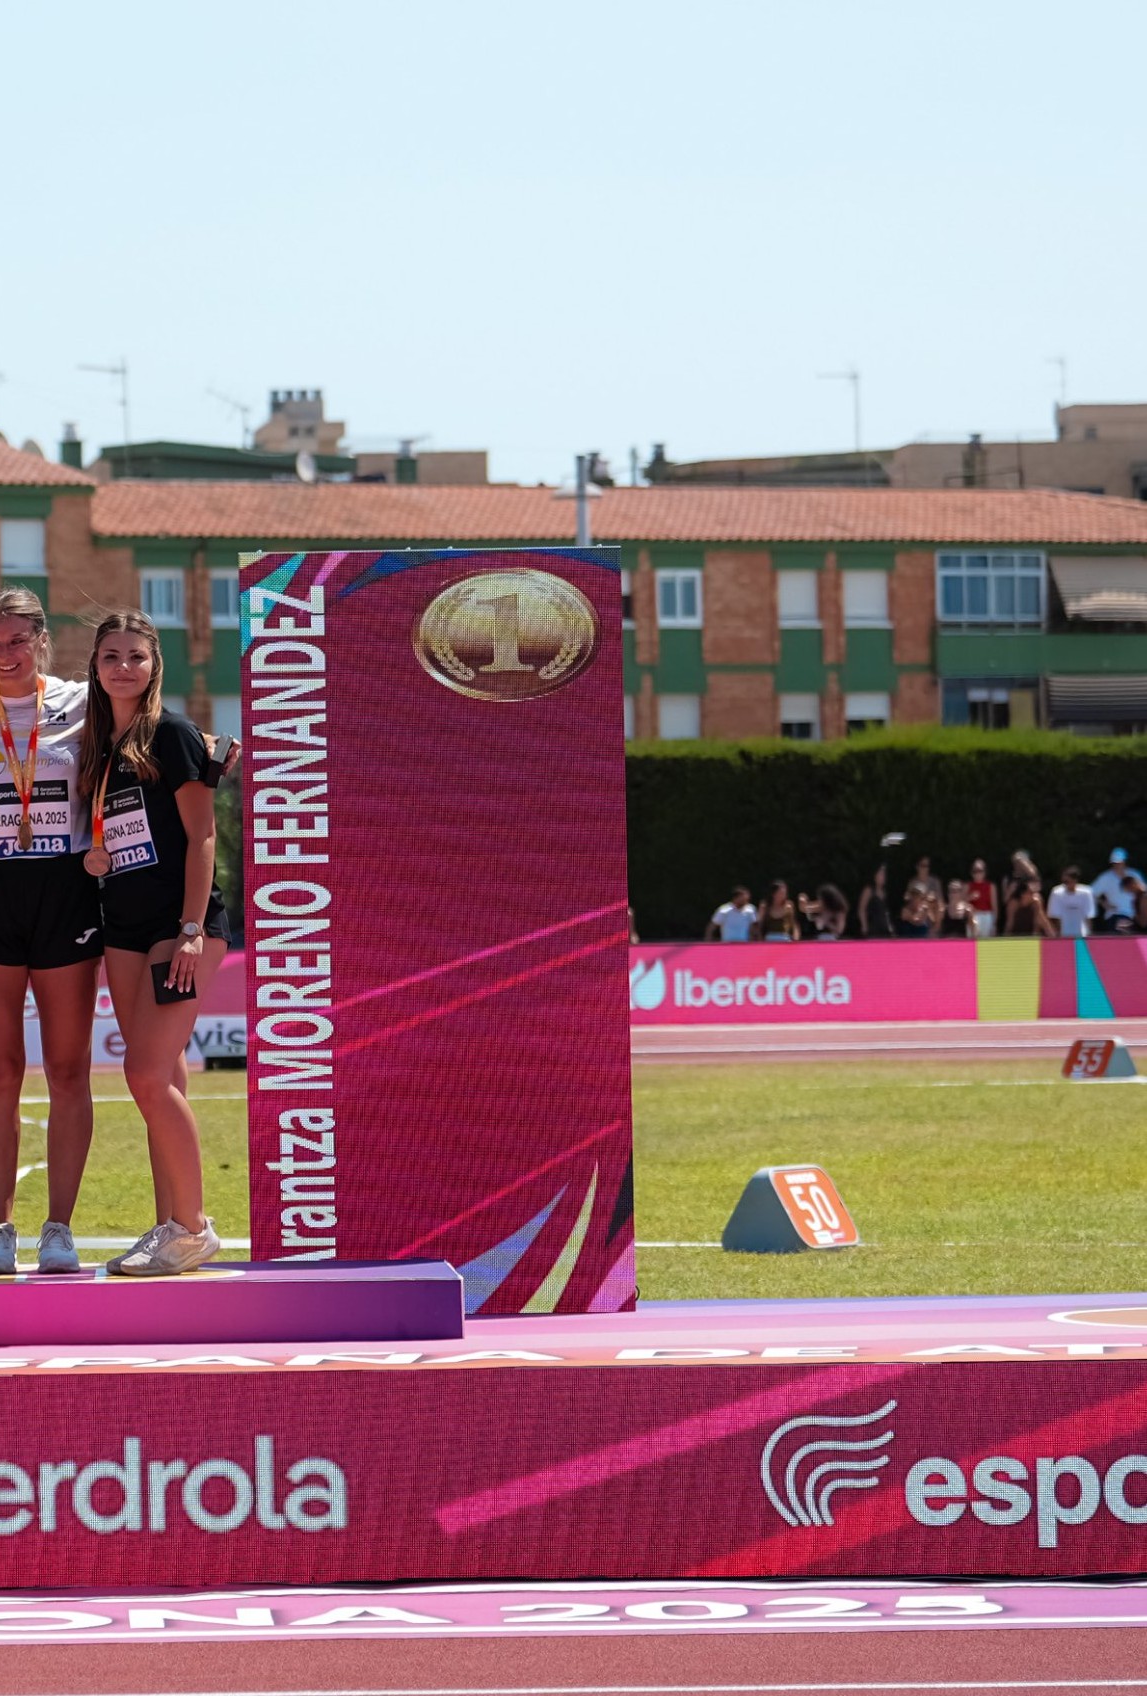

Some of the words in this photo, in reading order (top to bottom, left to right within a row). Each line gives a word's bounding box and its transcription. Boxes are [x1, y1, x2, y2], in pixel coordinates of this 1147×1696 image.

[249, 585, 330, 865] FERNANDEZ
[45, 811, 68, 824] 2025
[126, 819, 146, 836] 2025
[254, 880, 334, 1090] MORENO
[673, 967, 851, 1007] Iberdrola
[789, 1184, 840, 1231] 50
[615, 1346, 858, 1359] DE
[904, 1453, 1147, 1549] espo
[500, 1594, 1004, 1624] 2025
